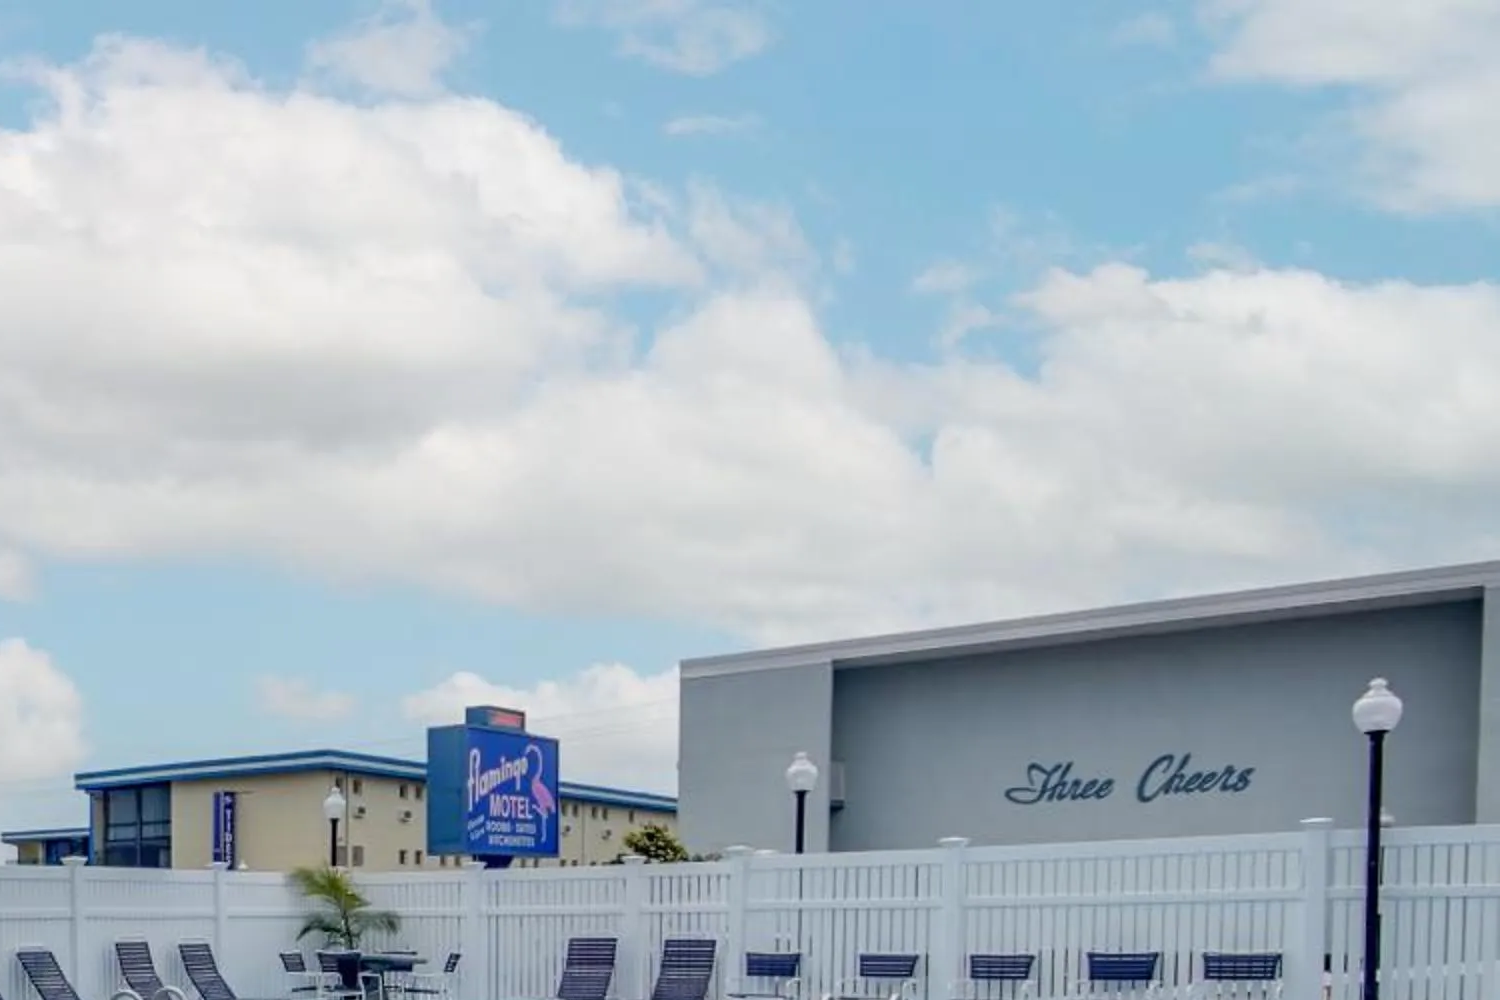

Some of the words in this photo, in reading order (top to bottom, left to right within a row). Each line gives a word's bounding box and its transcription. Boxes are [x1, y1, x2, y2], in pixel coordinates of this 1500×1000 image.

[1004, 761, 1114, 804] Three
[1137, 752, 1256, 803] Cheers
[490, 794, 533, 819] MOTEL
